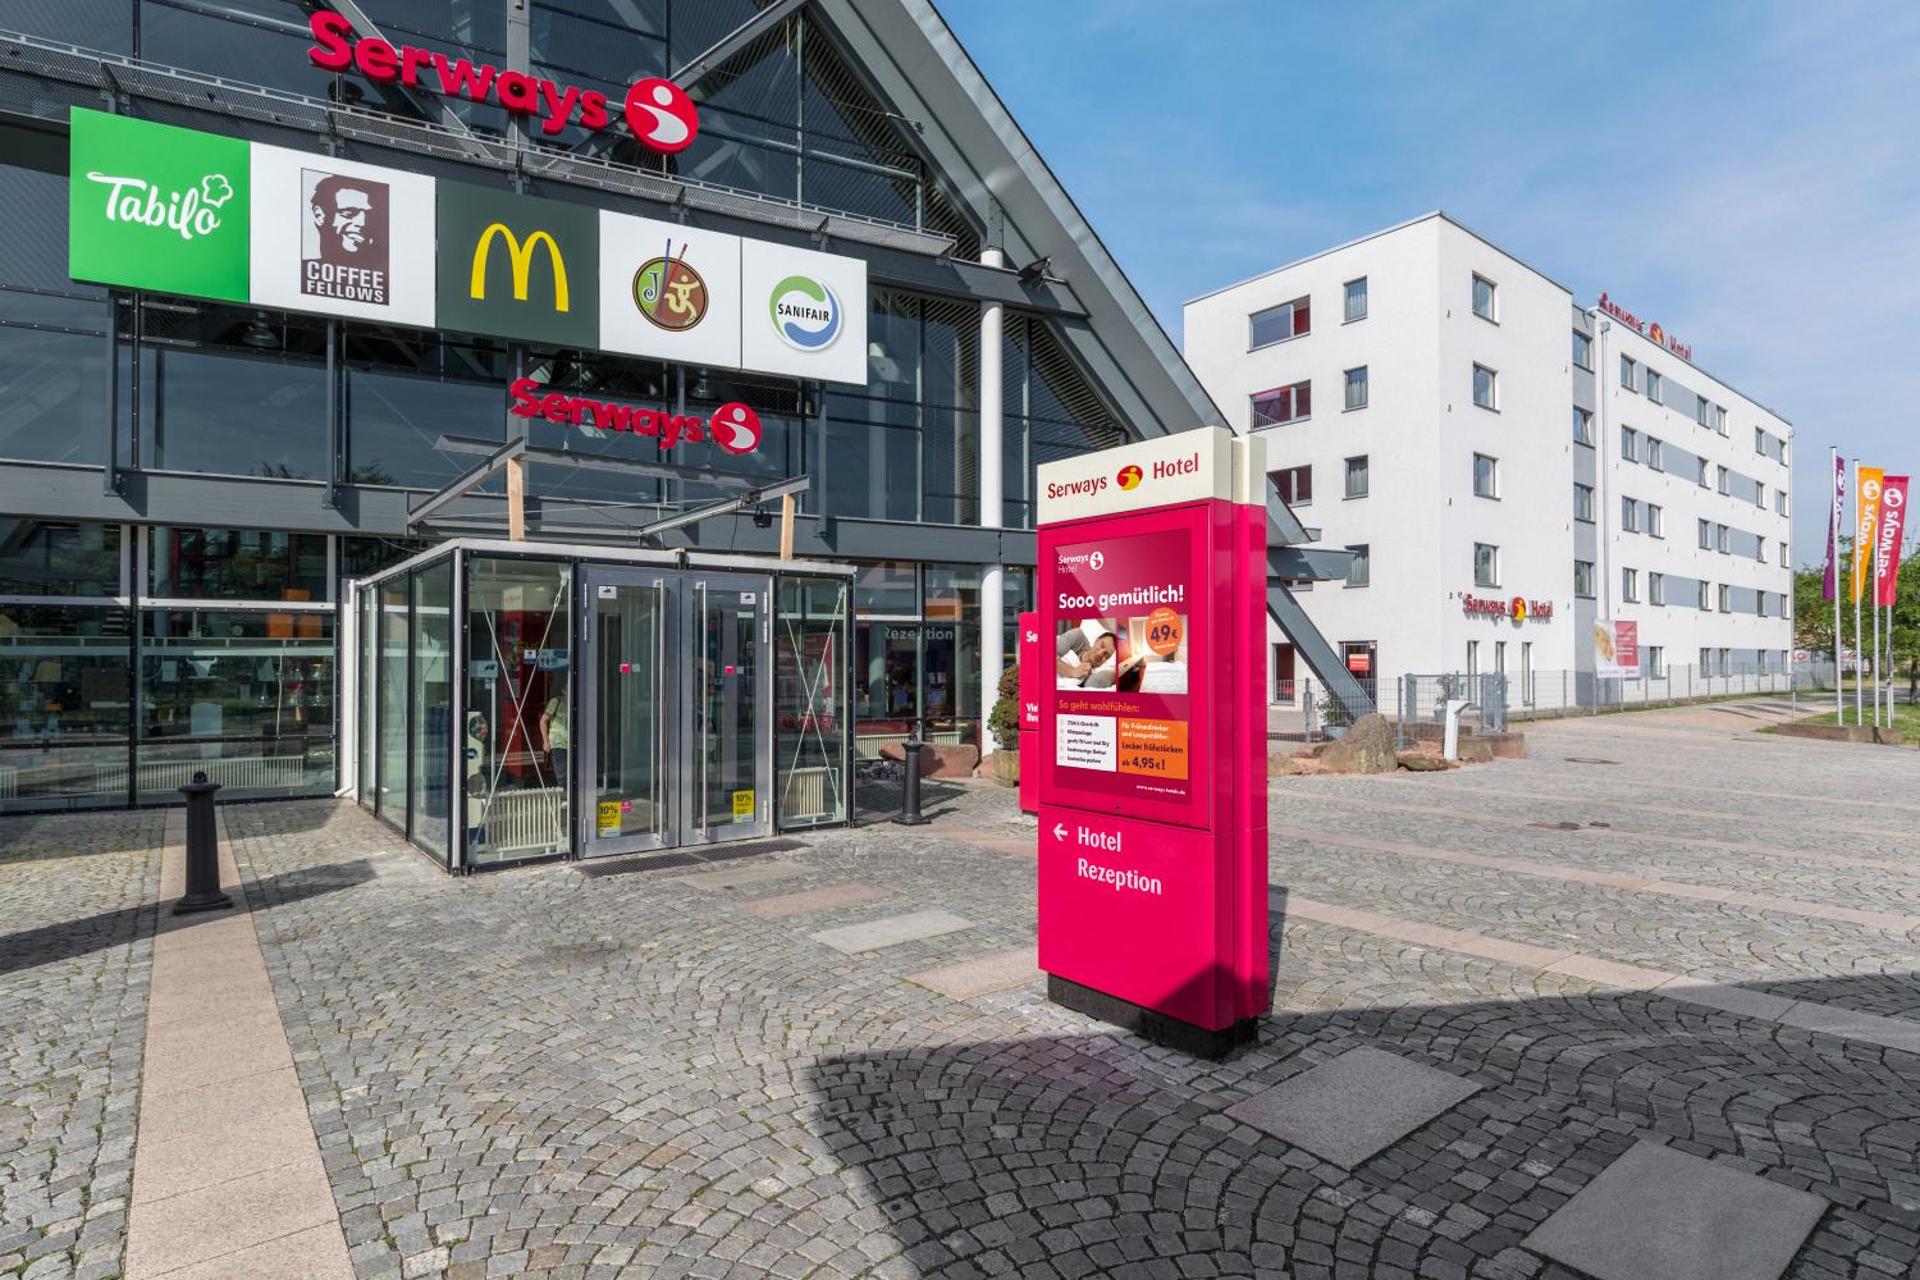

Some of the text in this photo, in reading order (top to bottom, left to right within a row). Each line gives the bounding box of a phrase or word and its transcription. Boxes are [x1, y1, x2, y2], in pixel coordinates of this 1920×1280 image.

[308, 9, 608, 134] Serways
[86, 171, 221, 240] Tabilo
[307, 260, 384, 290] COFFEE
[306, 280, 384, 303] FELLOWS
[777, 302, 830, 322] SANIFAIR
[510, 376, 704, 450] Serways
[1047, 452, 1200, 500] Serways Hotel
[1058, 554, 1089, 565] Serways
[1058, 584, 1185, 612] Sooo gemütlich!
[1531, 600, 1554, 618] Hotel
[1058, 699, 1141, 714] So geht wohlfühlen:
[1122, 741, 1143, 751] Lecker
[1144, 743, 1184, 755] frühstücken
[1122, 759, 1131, 767] ab
[1077, 825, 1122, 853] Hotel
[1077, 857, 1163, 896] Rezeption
